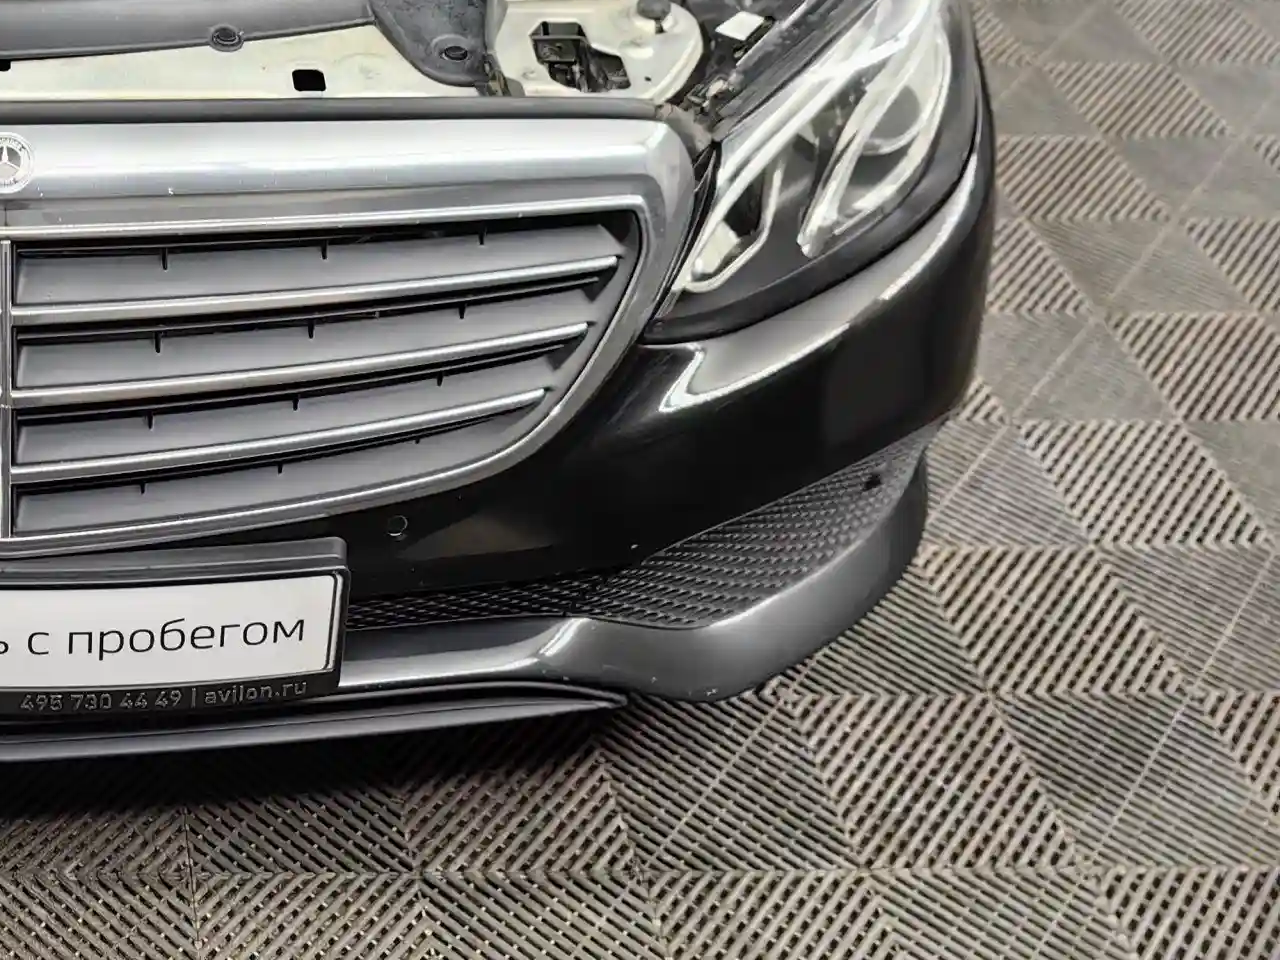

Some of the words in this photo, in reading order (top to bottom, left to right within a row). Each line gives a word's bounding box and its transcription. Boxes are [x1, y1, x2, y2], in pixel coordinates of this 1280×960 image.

[27, 631, 50, 656] с
[68, 617, 306, 662] пробегом
[19, 693, 63, 712] 495
[70, 692, 113, 711] 730
[119, 691, 149, 709] 44
[154, 689, 183, 709] 49
[204, 681, 308, 706] avilon.ru
